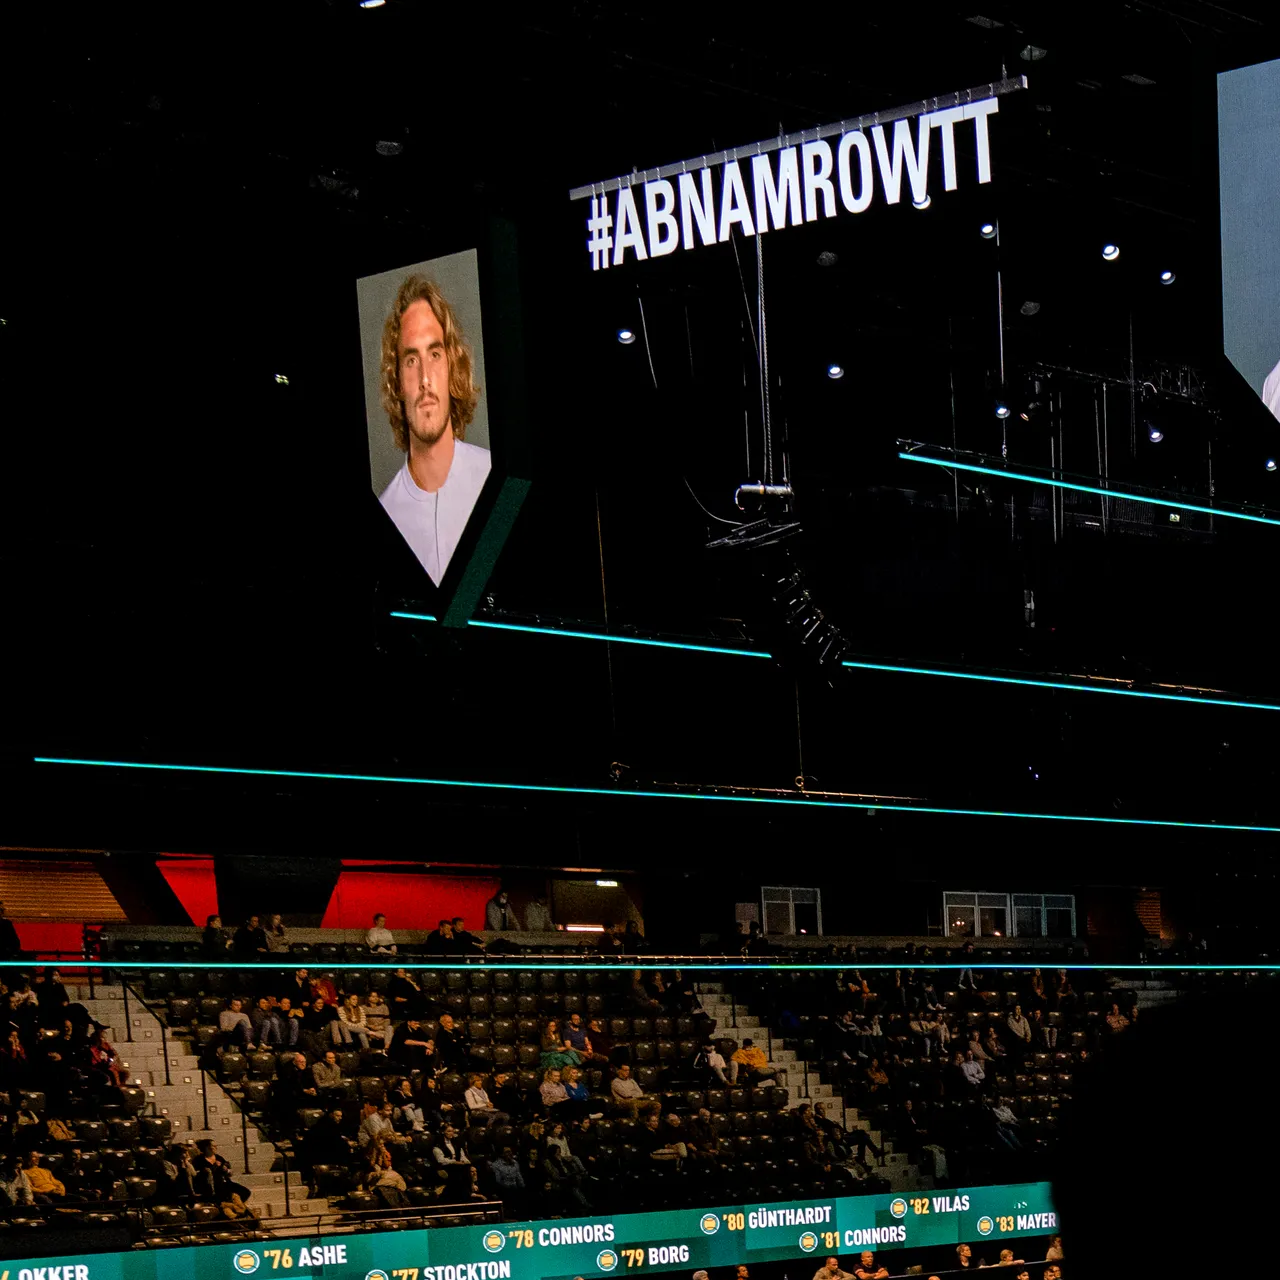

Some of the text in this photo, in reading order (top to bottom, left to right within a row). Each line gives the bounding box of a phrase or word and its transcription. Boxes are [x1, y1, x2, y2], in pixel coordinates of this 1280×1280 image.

[587, 97, 999, 272] #ABNAMROWTT
[910, 1194, 970, 1215] '82 VILAS
[723, 1205, 832, 1231] '80 GÜNTHARDT
[996, 1211, 1057, 1232] '83 MAYER
[508, 1223, 616, 1250] '78 CONNORS
[820, 1225, 907, 1249] '81 CONNORS
[263, 1244, 348, 1270] '76 ASHE
[621, 1244, 690, 1268] '79 BORG
